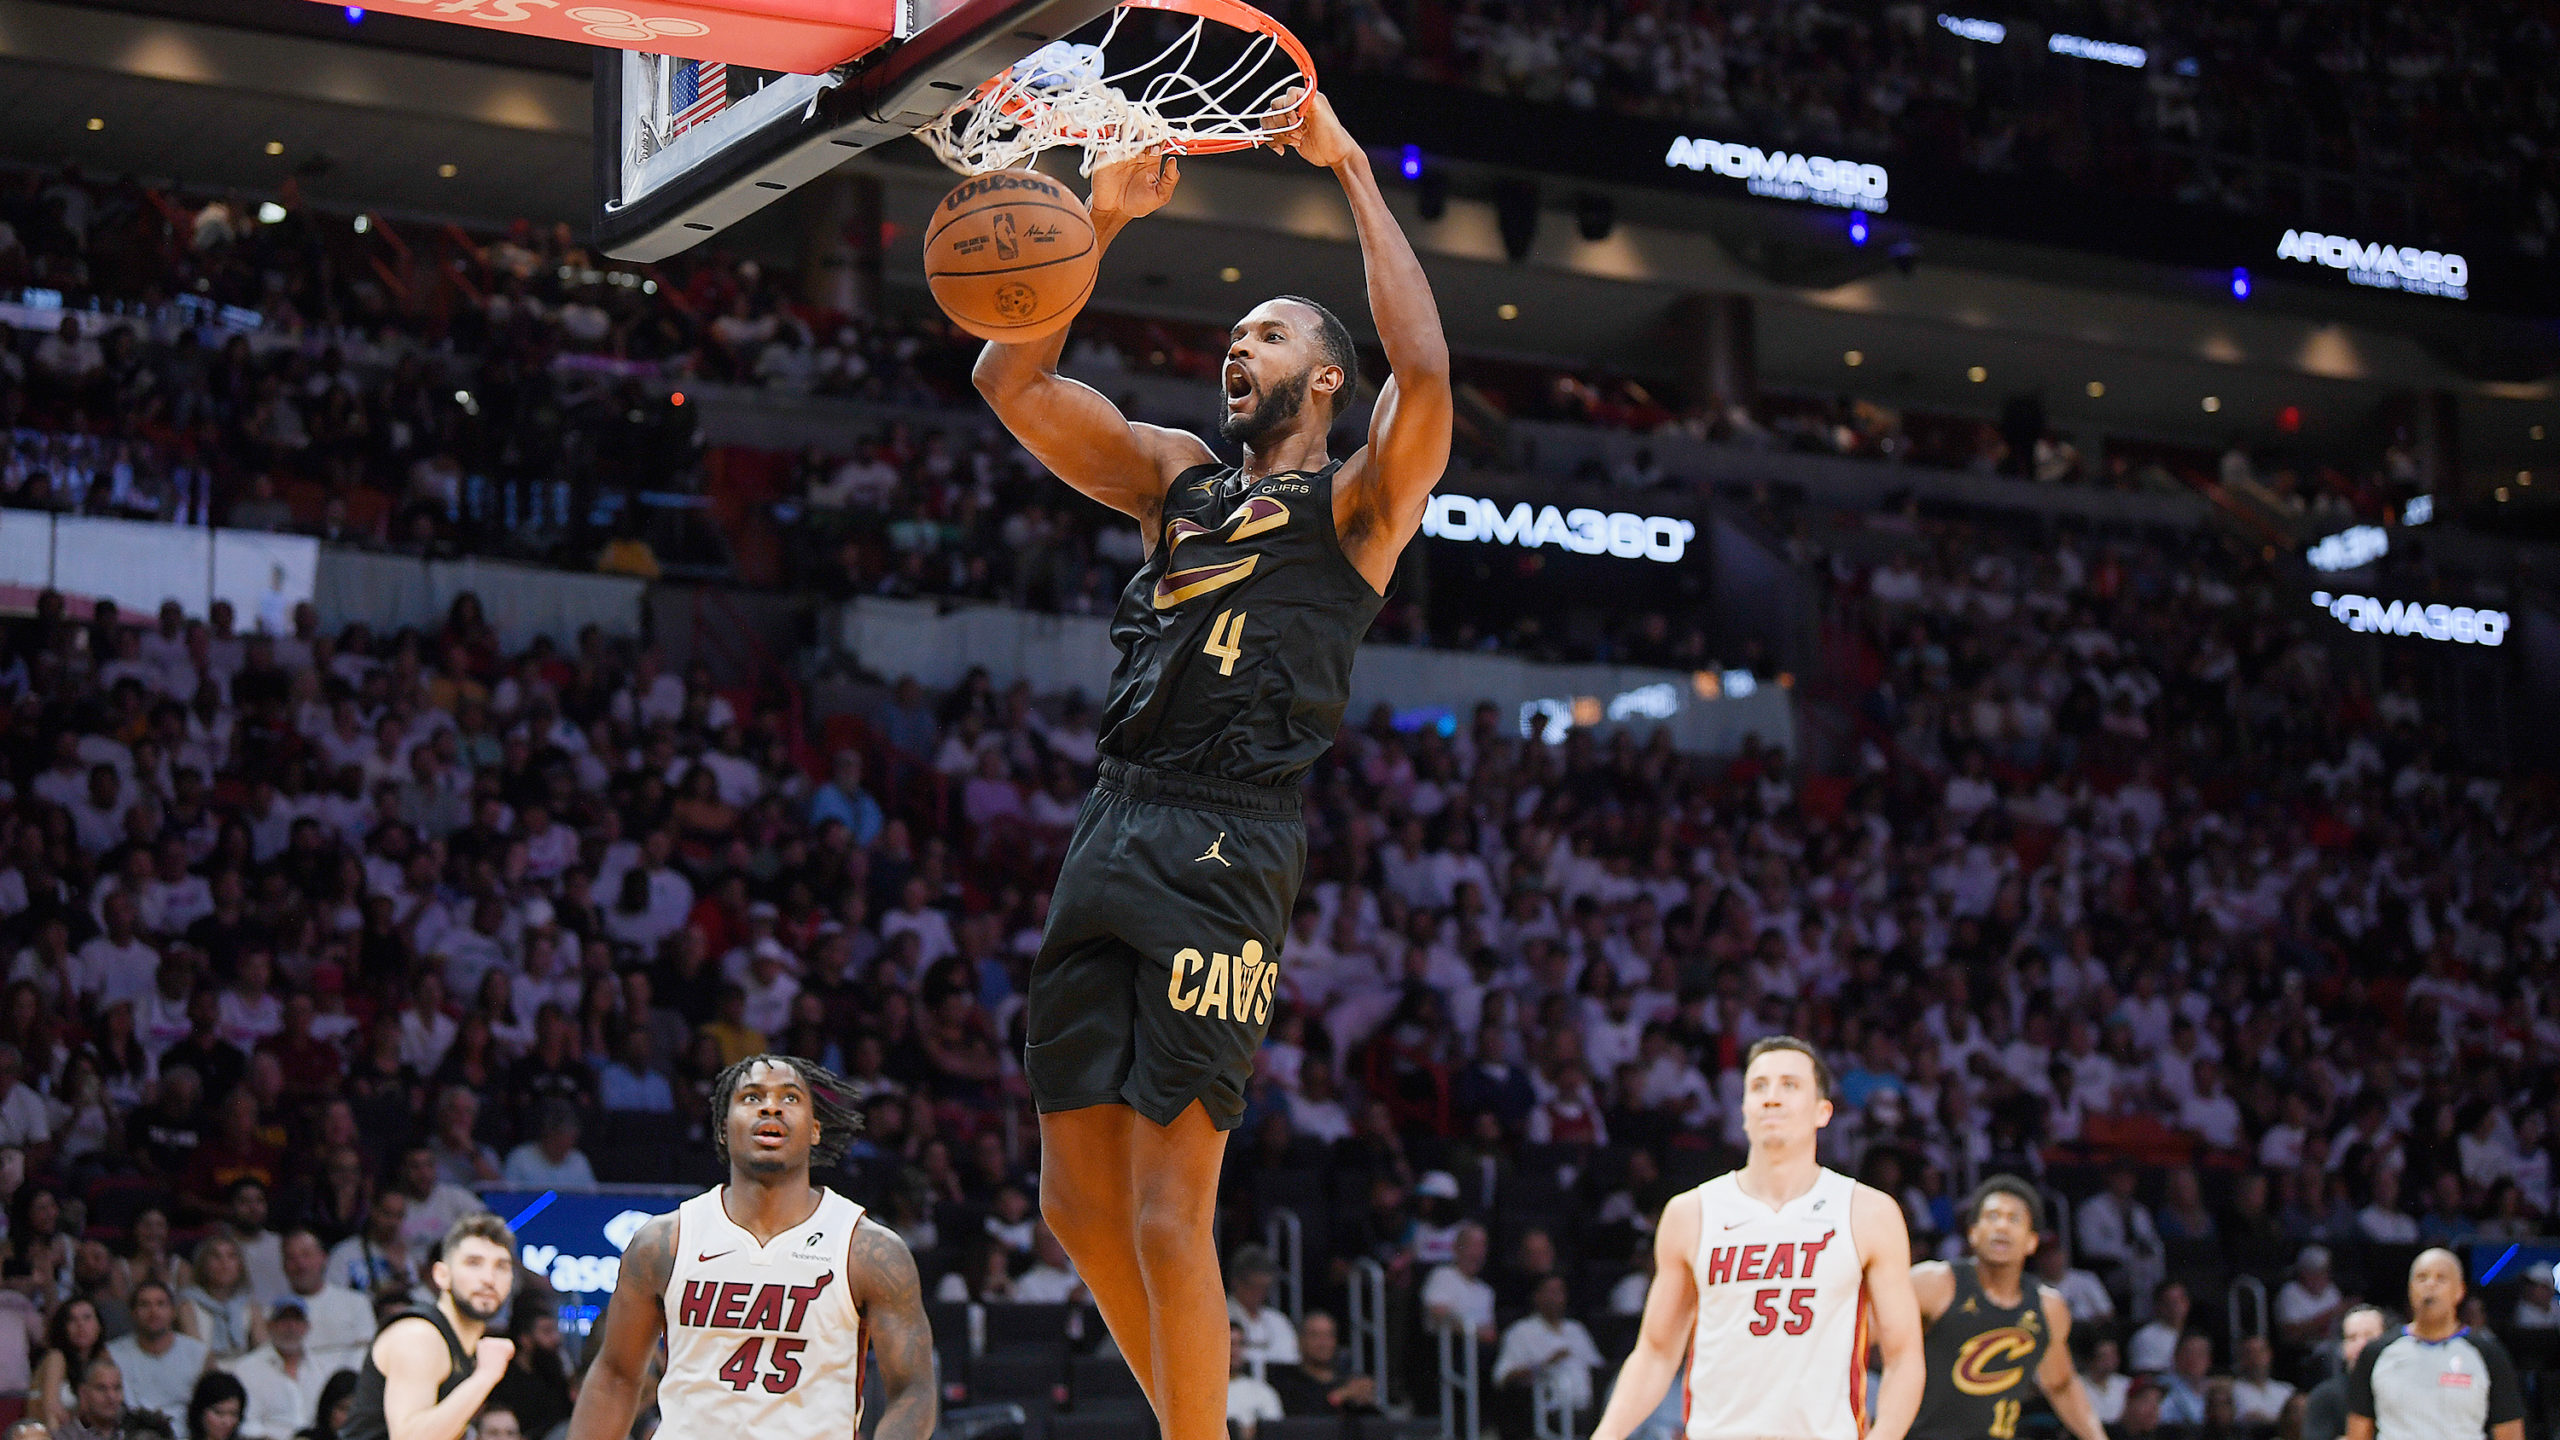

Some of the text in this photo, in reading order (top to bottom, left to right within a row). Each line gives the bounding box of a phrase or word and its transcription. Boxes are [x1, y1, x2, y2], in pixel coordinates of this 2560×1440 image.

[947, 174, 1060, 211] Wilson
[1261, 483, 1311, 495] CLIFFS
[1202, 607, 1248, 677] 4
[1167, 939, 1279, 1026] CAVS
[521, 1243, 622, 1294] Kase
[1708, 1228, 1837, 1287] HEAT
[679, 1268, 835, 1334] HEAT
[1749, 1288, 1817, 1337] 55
[719, 1336, 809, 1395] 45
[1987, 1398, 2022, 1440] 11
